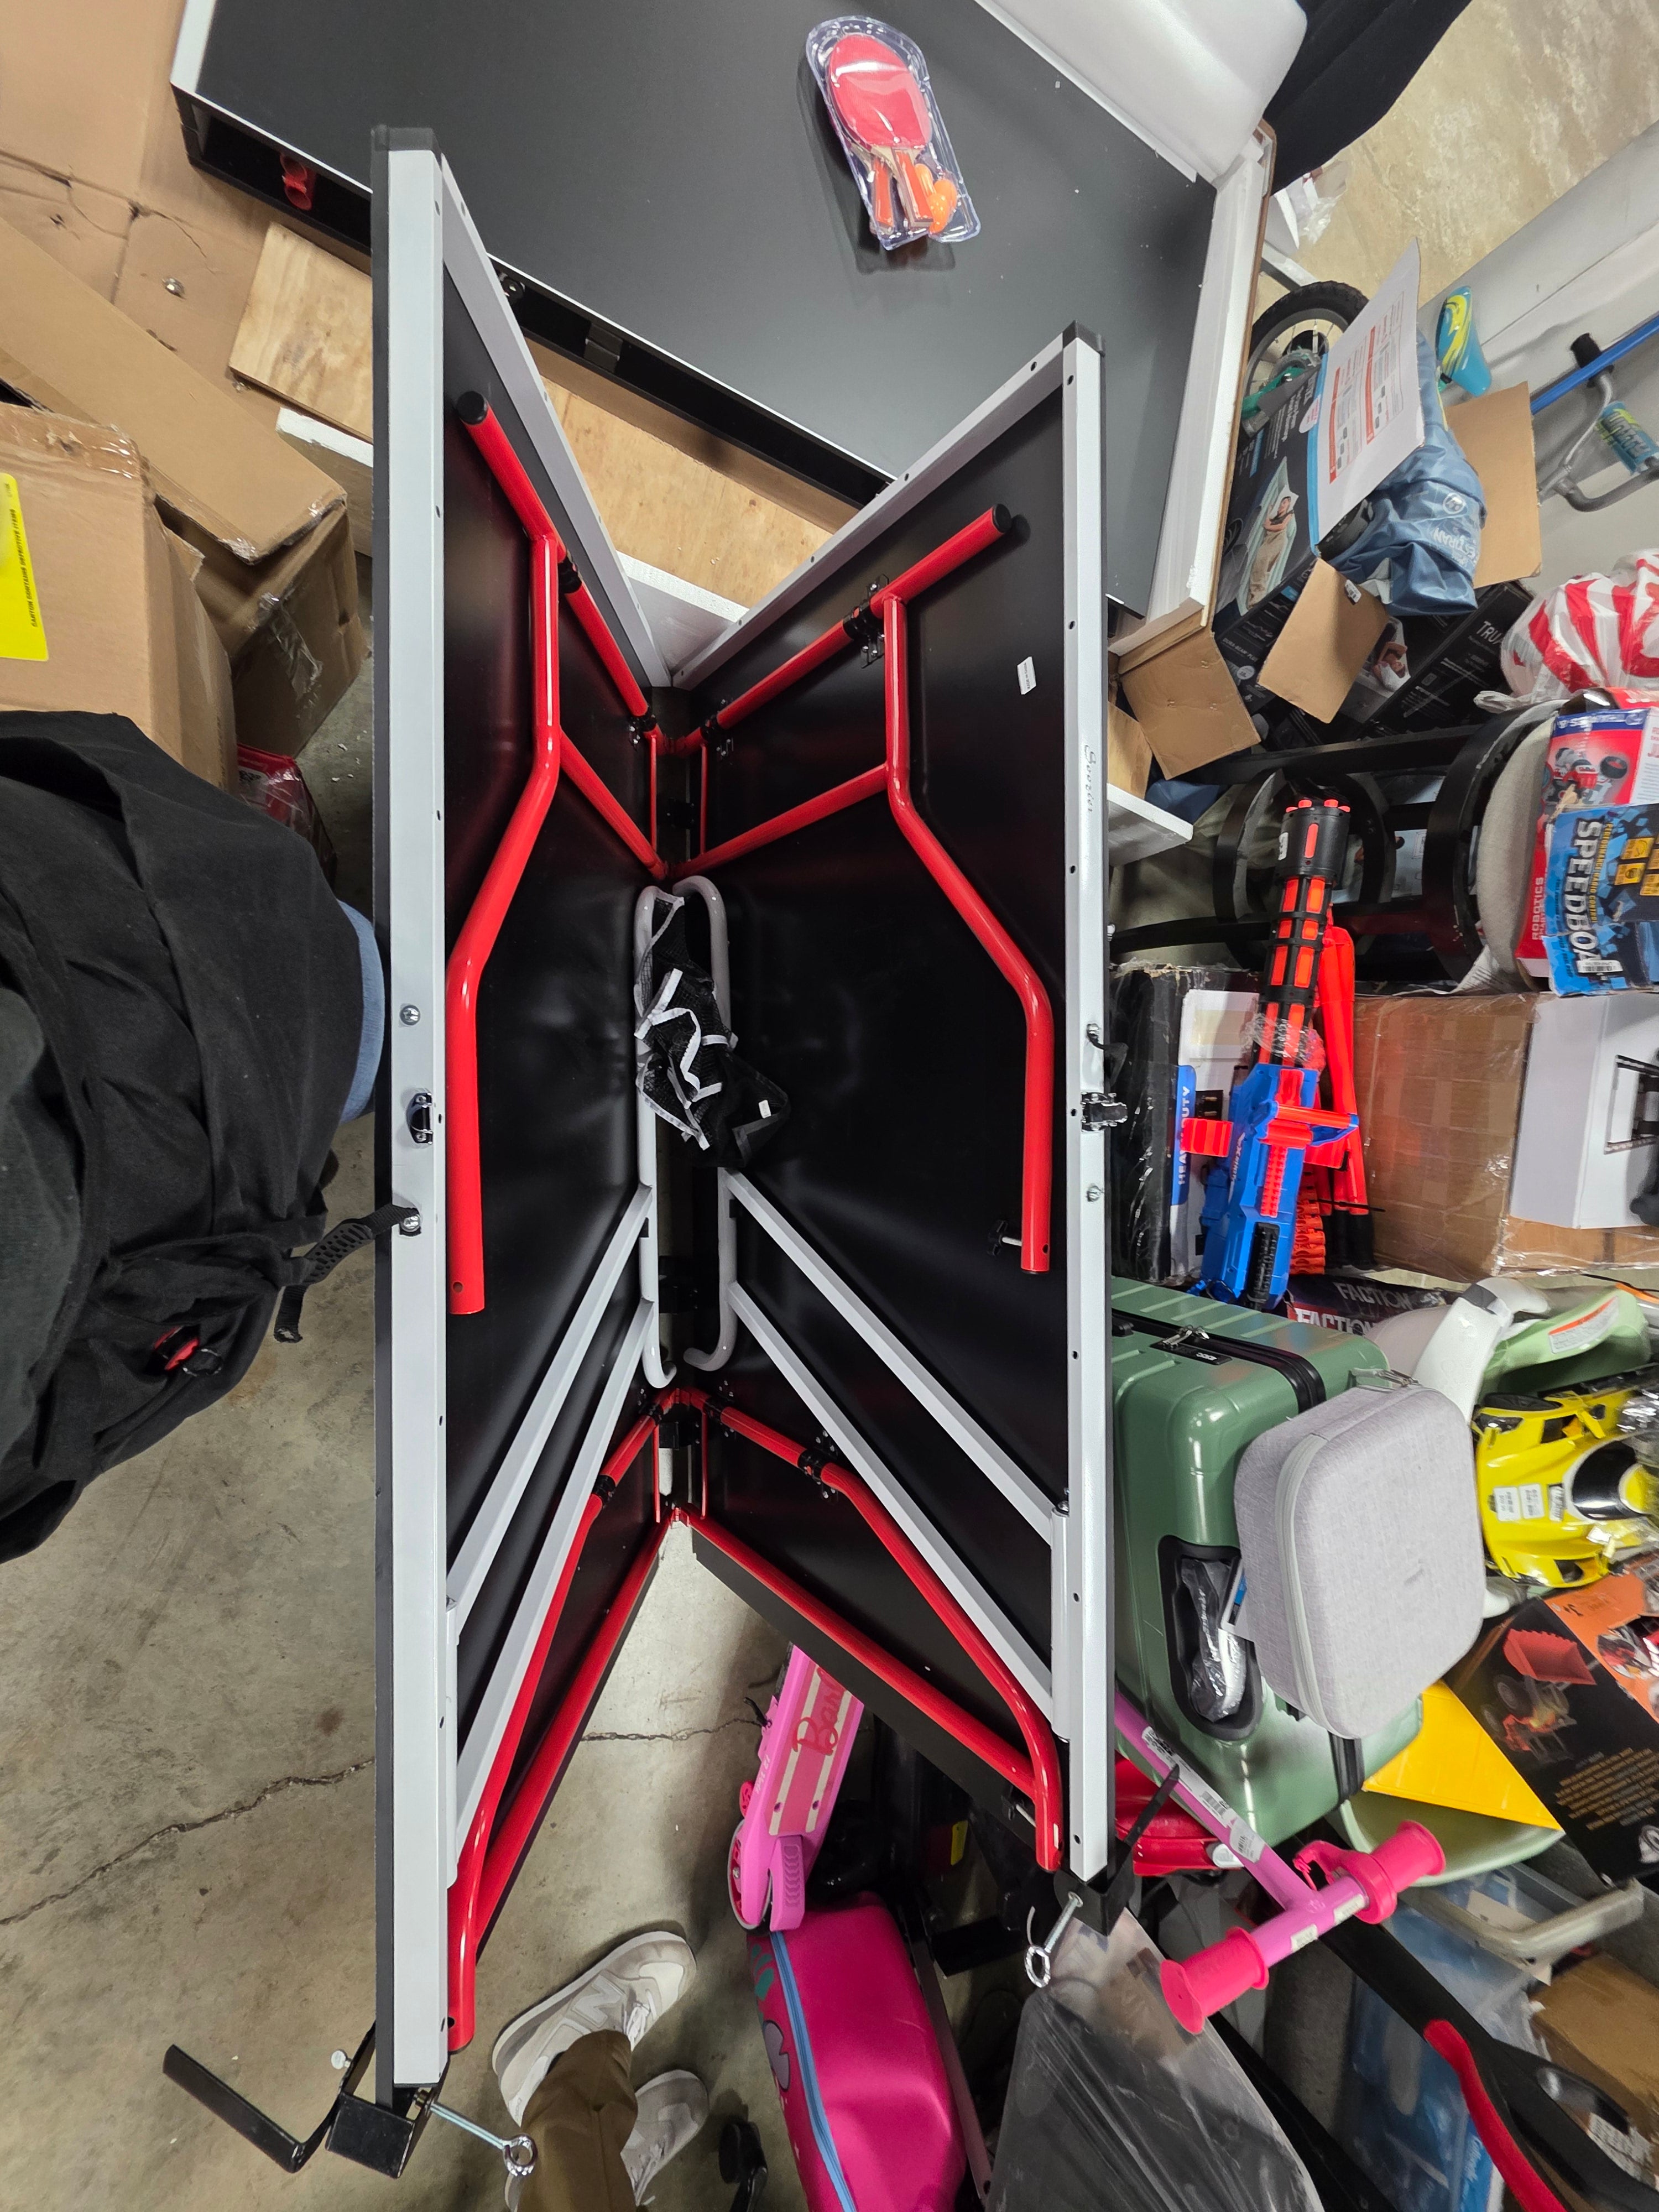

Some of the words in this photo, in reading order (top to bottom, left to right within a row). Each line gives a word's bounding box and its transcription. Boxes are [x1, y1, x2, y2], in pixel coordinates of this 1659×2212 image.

[1596, 823, 1613, 870] PERFORMANCE
[1564, 821, 1604, 968] SPEEDBOA
[1590, 872, 1600, 894] RADIO
[1532, 877, 1544, 940] ROBOTICS
[1333, 1281, 1412, 1311] FACTION
